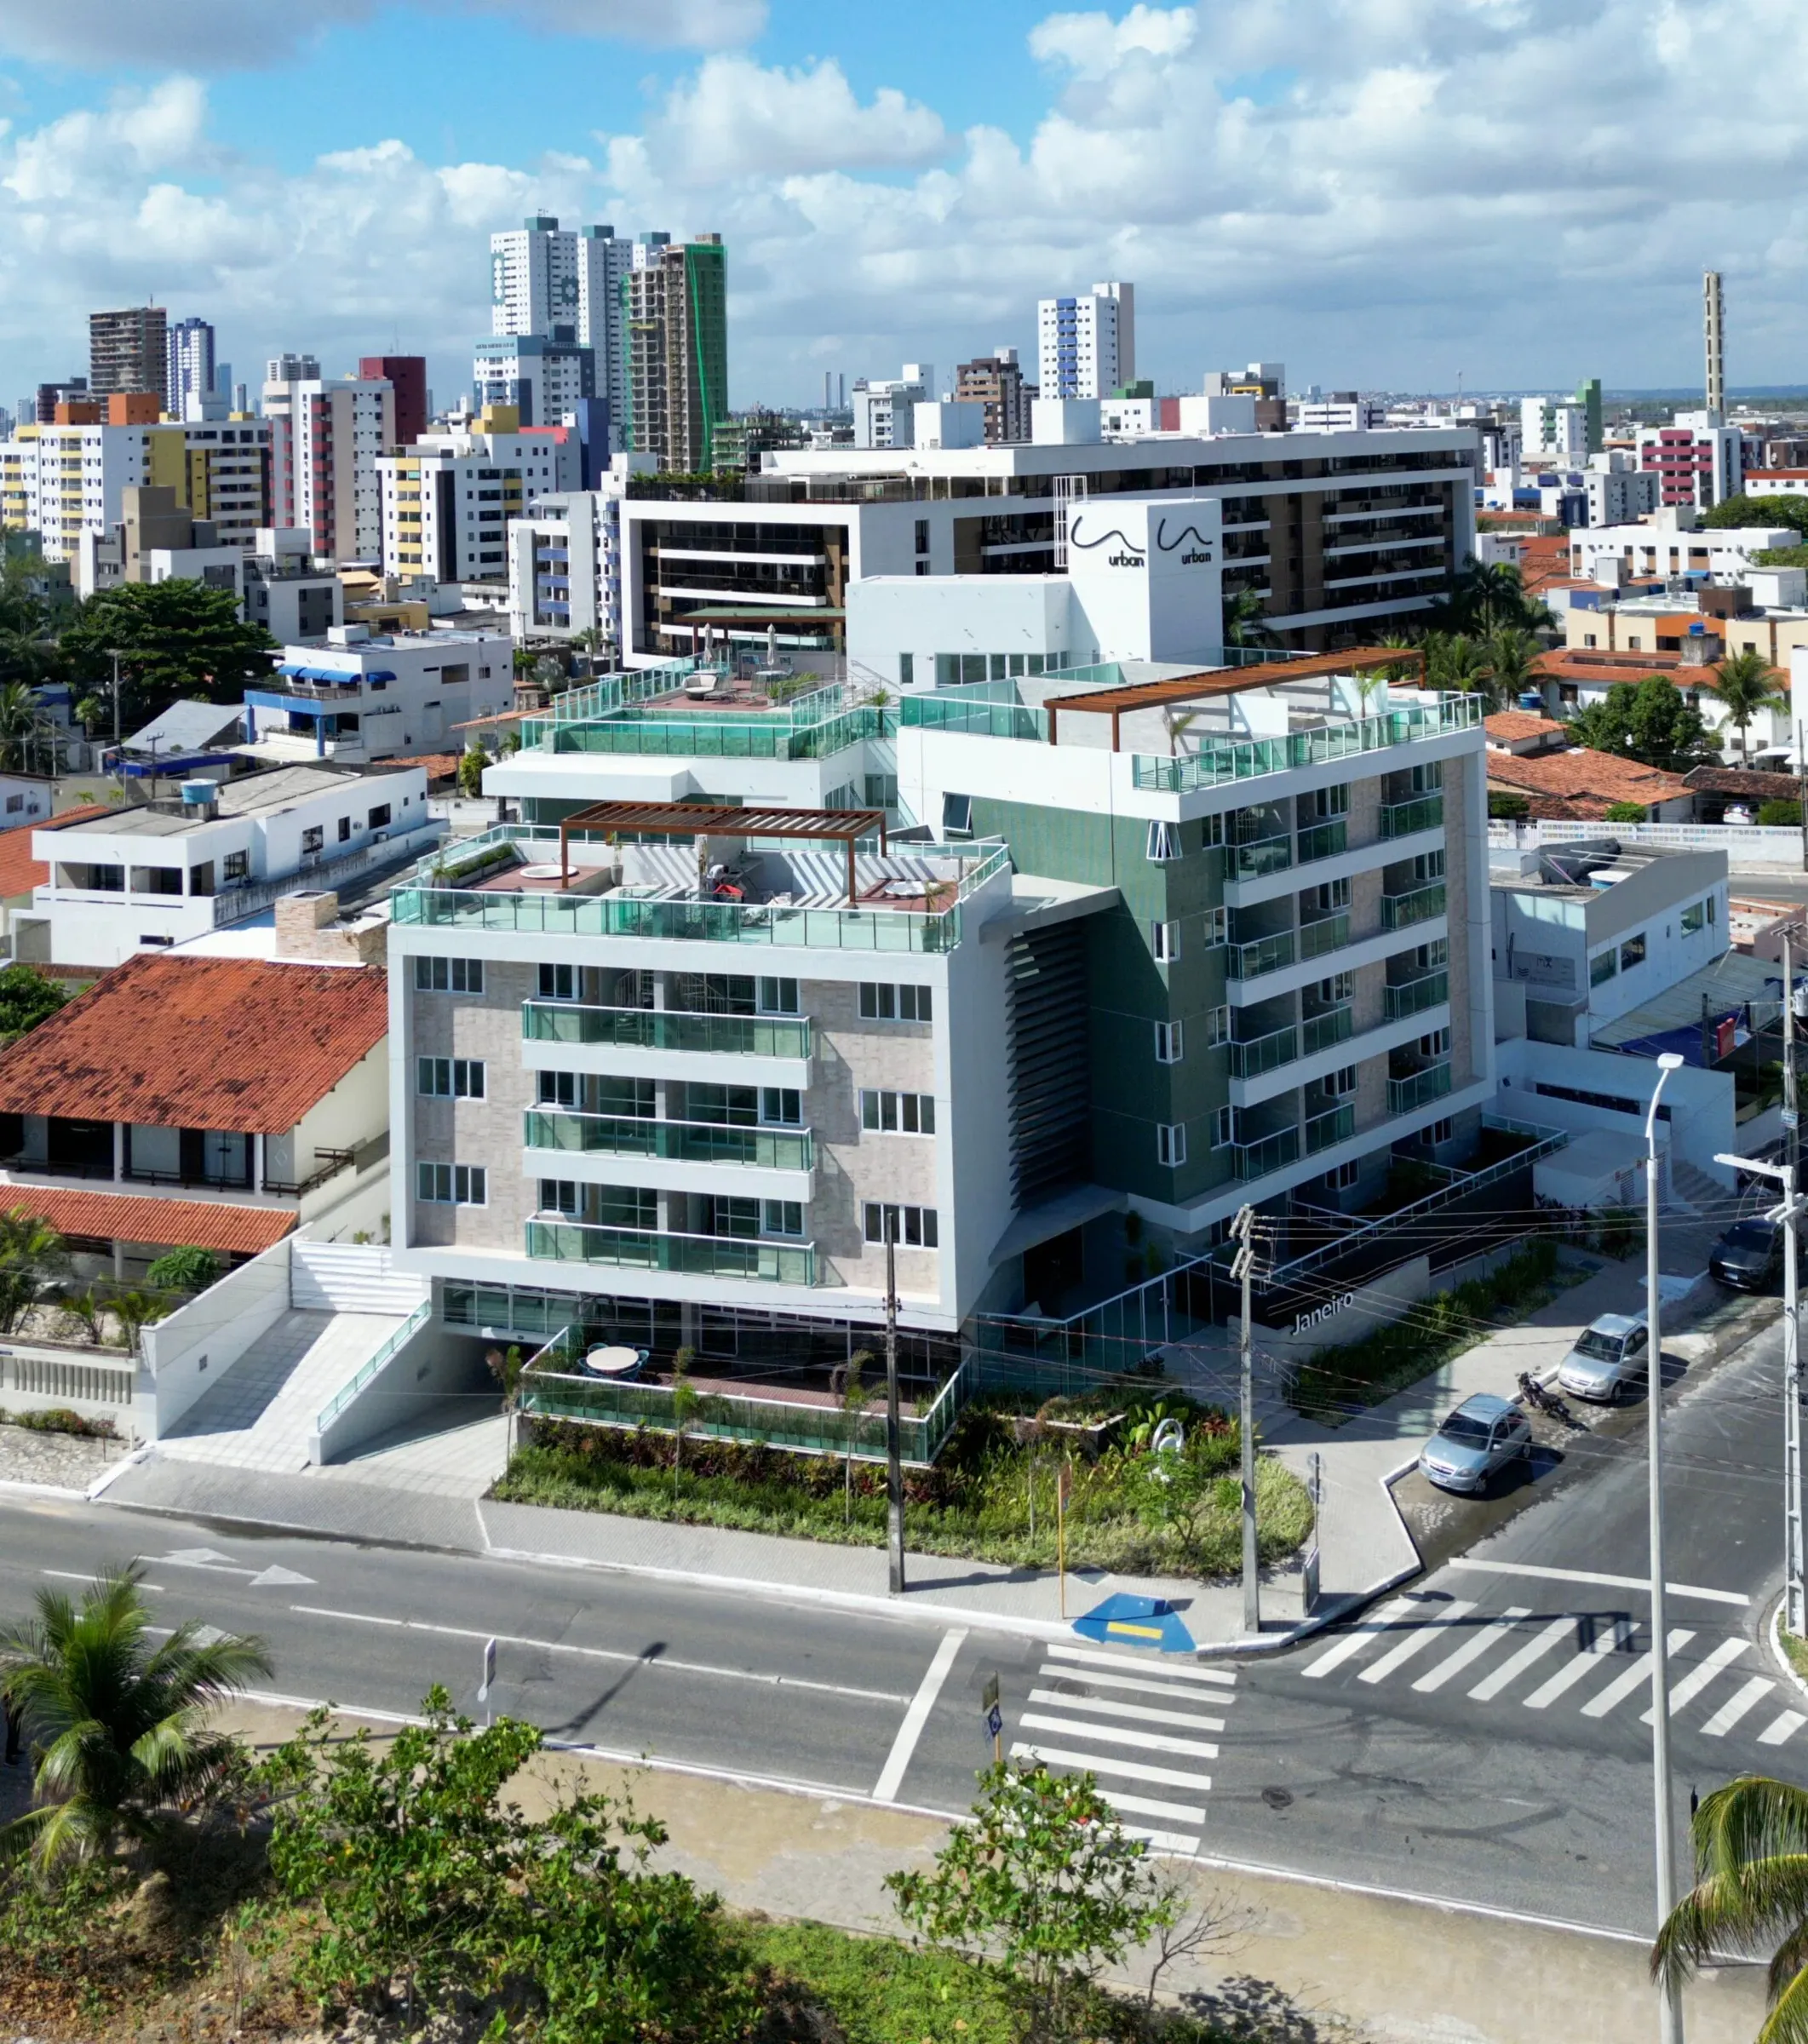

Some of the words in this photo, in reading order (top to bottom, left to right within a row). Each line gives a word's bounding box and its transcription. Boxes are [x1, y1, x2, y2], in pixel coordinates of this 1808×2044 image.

[1109, 551, 1145, 567] urban
[1181, 547, 1212, 566] urban
[1292, 1292, 1355, 1336] Janeiro
